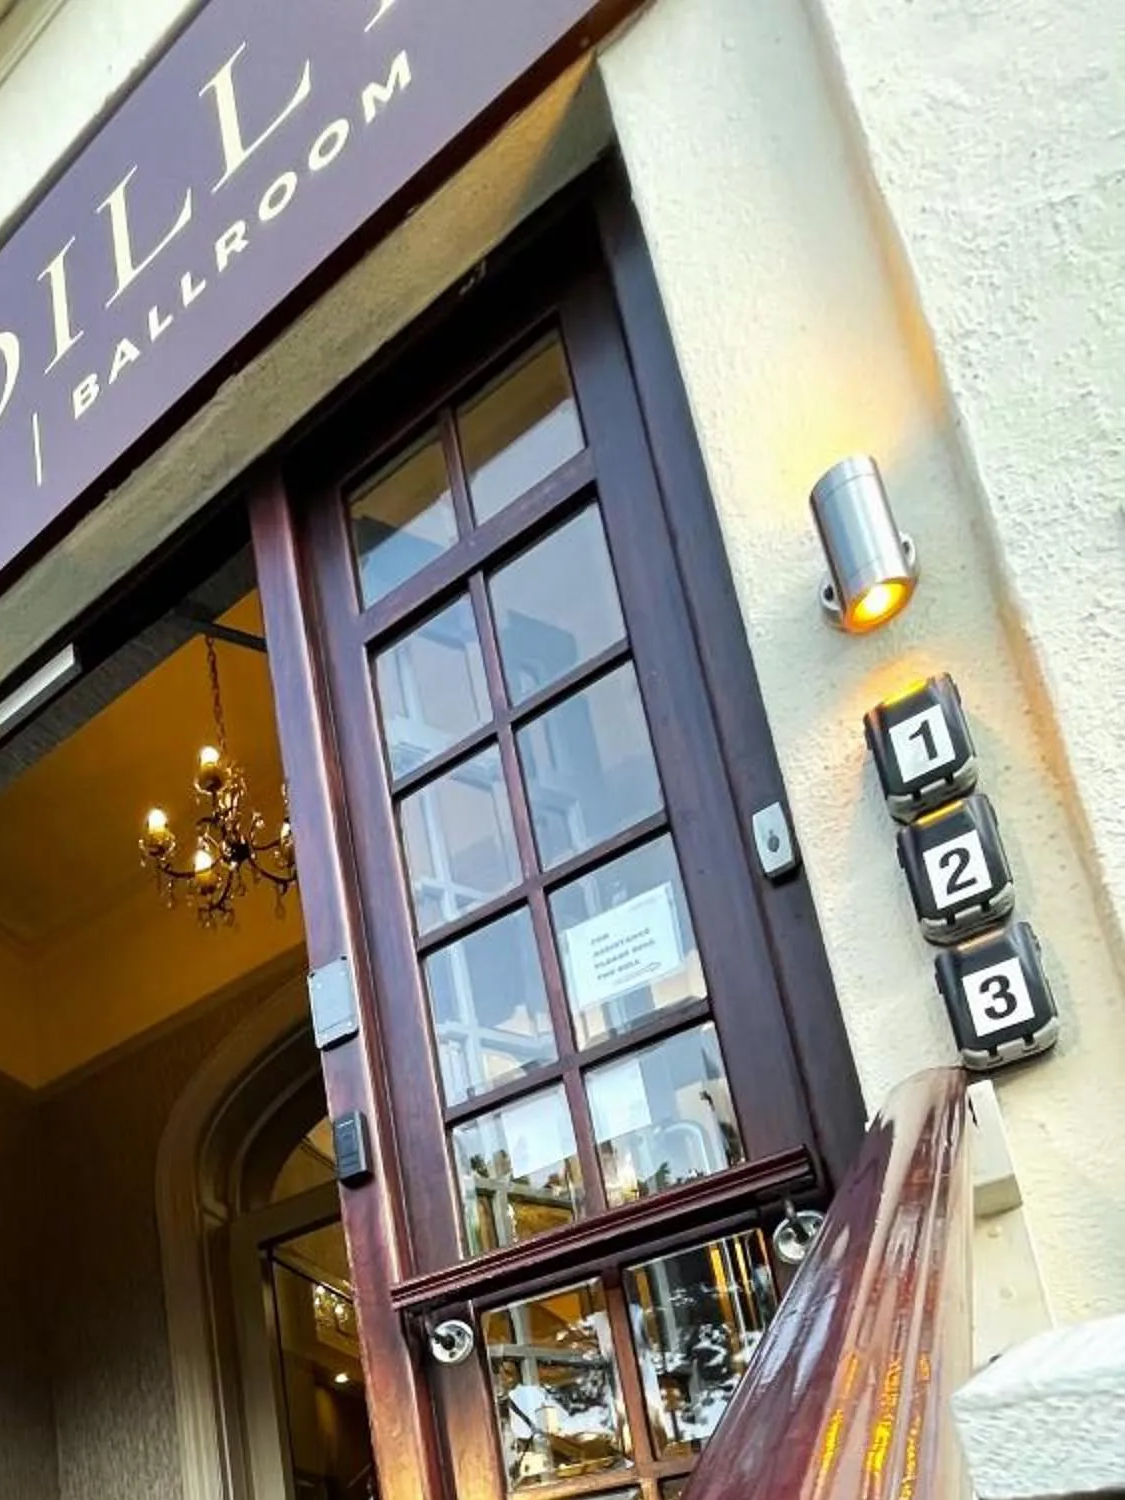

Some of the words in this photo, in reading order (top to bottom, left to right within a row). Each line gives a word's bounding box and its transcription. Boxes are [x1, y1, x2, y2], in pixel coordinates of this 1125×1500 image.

[73, 49, 413, 420] BALLROOM
[907, 720, 939, 763] 1
[938, 847, 976, 894] 2
[979, 974, 1019, 1020] 3
